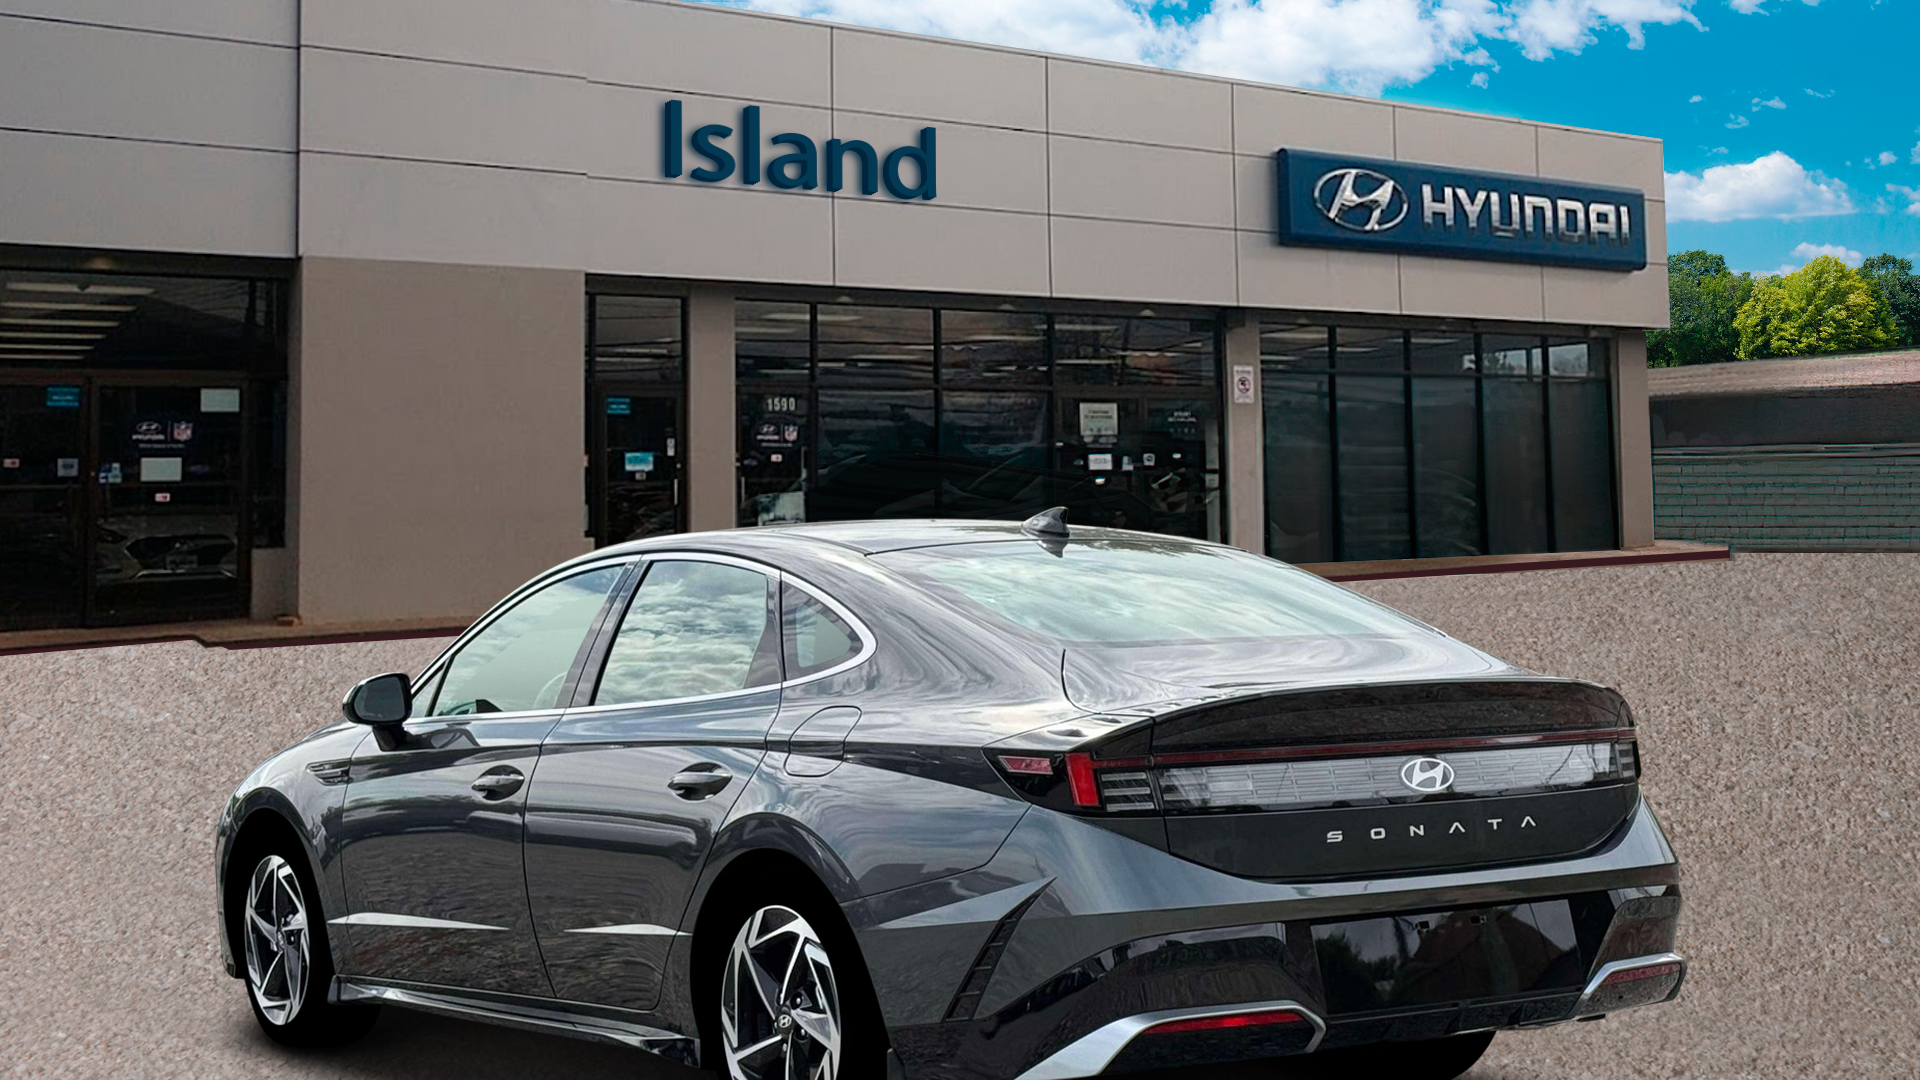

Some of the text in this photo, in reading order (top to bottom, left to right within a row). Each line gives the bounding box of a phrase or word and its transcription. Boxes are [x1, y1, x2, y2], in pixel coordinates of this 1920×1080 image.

[664, 99, 937, 200] Island
[1421, 184, 1631, 245] HYUNDAI
[766, 397, 796, 412] 1590
[1326, 815, 1537, 843] SONATA
